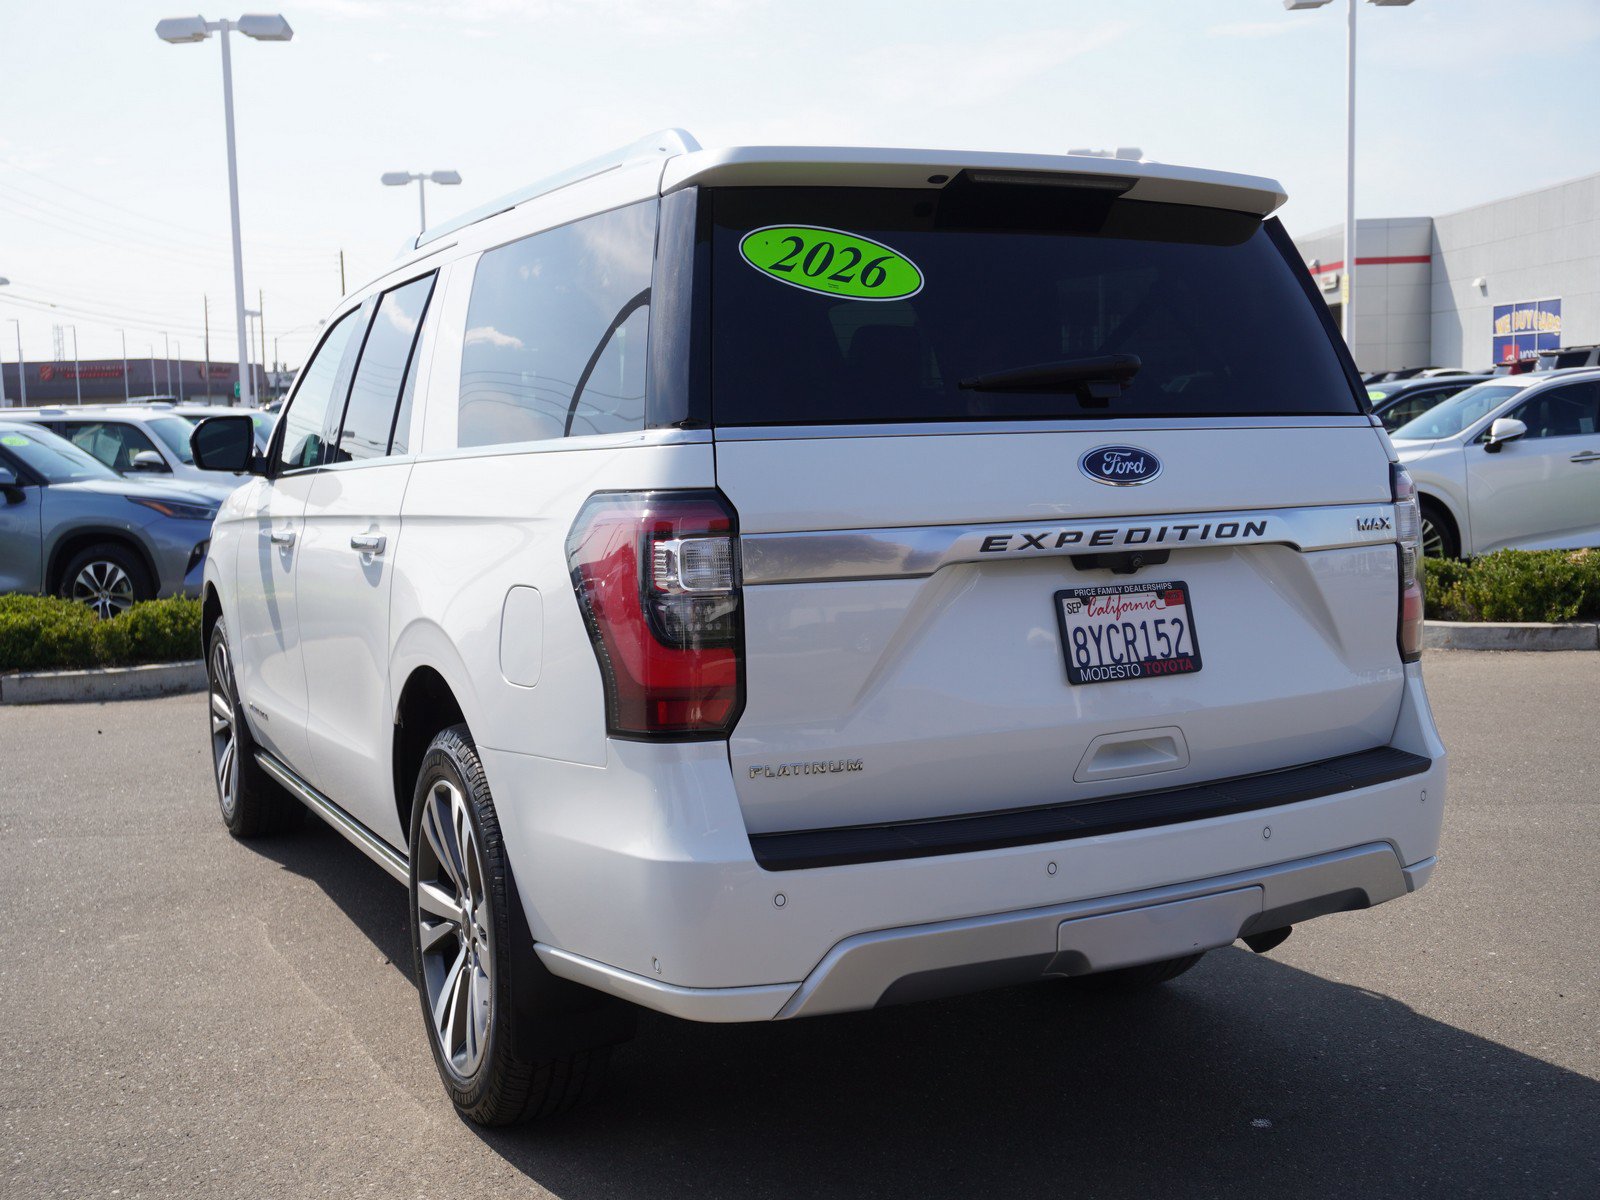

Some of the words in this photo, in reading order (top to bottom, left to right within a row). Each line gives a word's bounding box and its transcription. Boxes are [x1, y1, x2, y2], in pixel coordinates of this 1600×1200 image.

[768, 236, 895, 288] 2026
[1495, 313, 1511, 335] WE
[1512, 309, 1534, 331] BUY
[1102, 451, 1147, 477] Ford
[979, 520, 1268, 553] EXPEDITION
[1356, 515, 1392, 532] MAX
[1074, 588, 1096, 597] PRICE
[1097, 585, 1123, 595] FAMILY
[1124, 582, 1173, 593] DEALERSHIPS
[1066, 601, 1082, 615] SEP
[1087, 595, 1166, 621] California
[1072, 618, 1189, 667] 8YCR152
[1080, 663, 1141, 682] MODESTO
[1143, 659, 1194, 675] TOYOTA
[749, 759, 864, 778] PLATINUM
